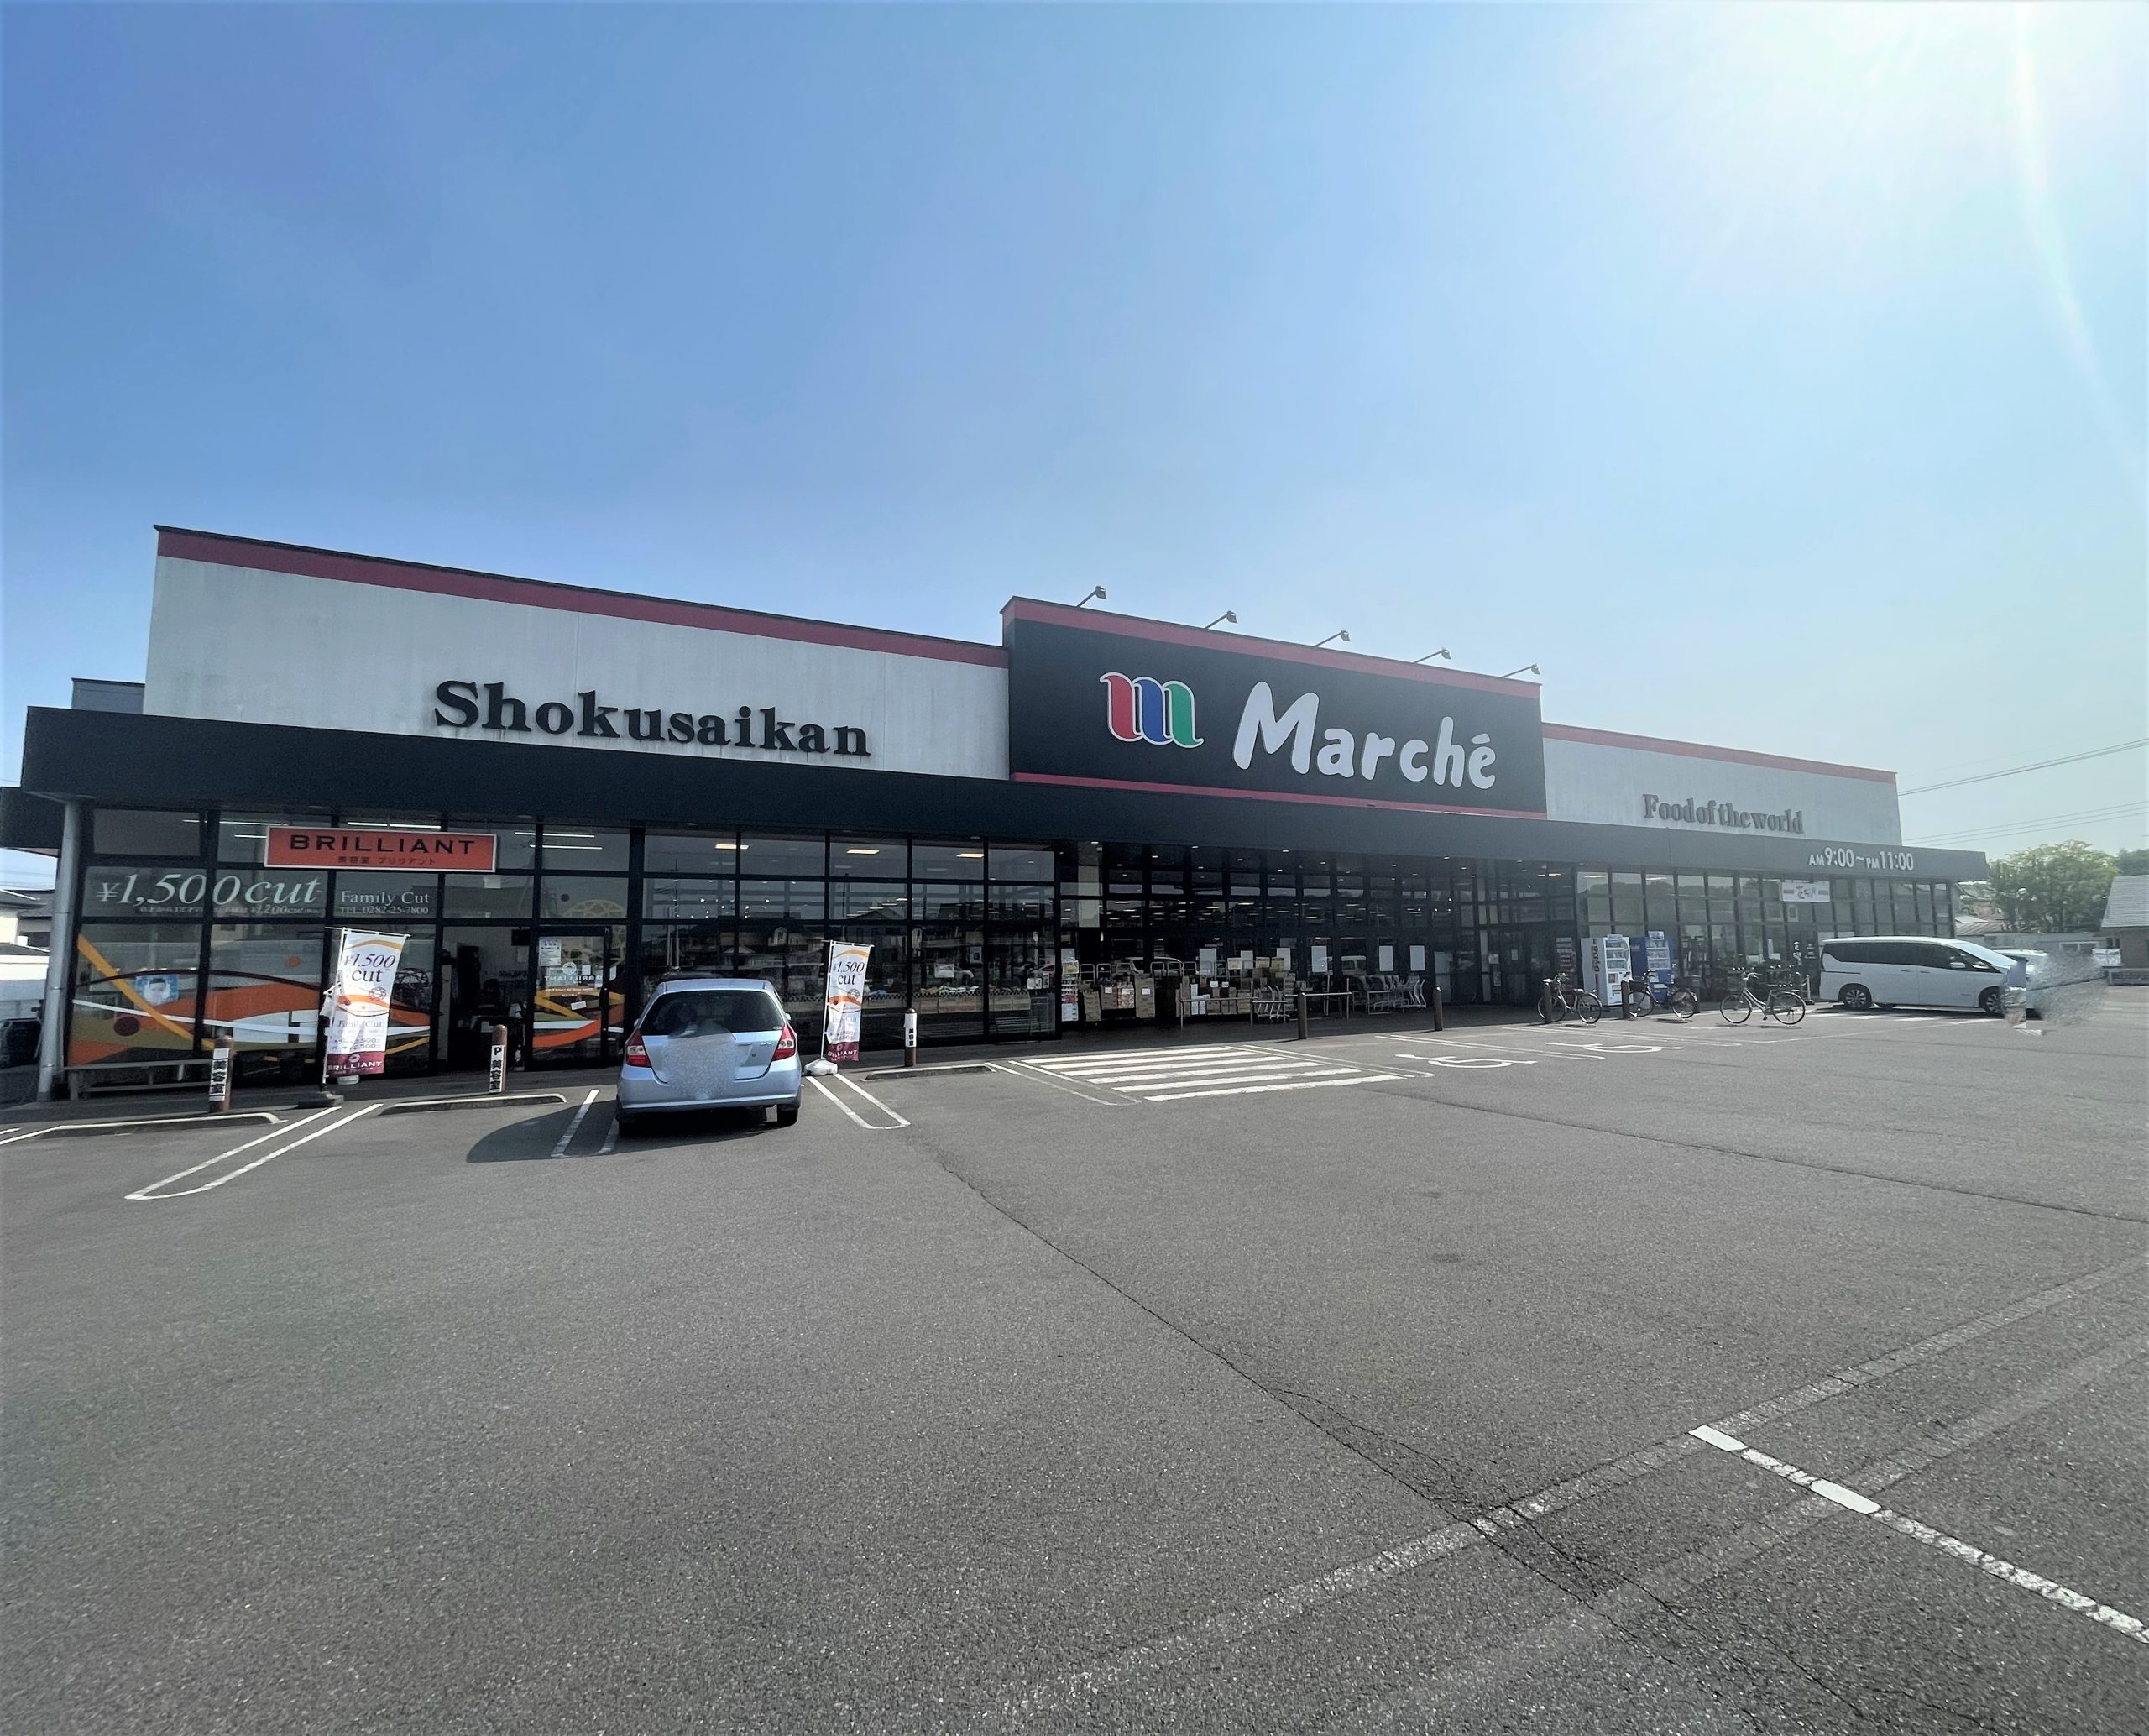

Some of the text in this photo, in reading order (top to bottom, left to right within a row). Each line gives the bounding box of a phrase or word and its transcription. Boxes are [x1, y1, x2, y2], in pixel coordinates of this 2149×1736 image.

[434, 679, 871, 757] Shokusaikan
[1231, 681, 1497, 790] Marché
[290, 834, 475, 855] BRILLIANT
[341, 891, 430, 906] Family Cut
[362, 906, 429, 915] 0282-25-7800
[352, 969, 384, 983] cut
[838, 974, 856, 986] cut
[494, 1047, 502, 1056] P
[327, 1061, 383, 1071] BRILLIANT
